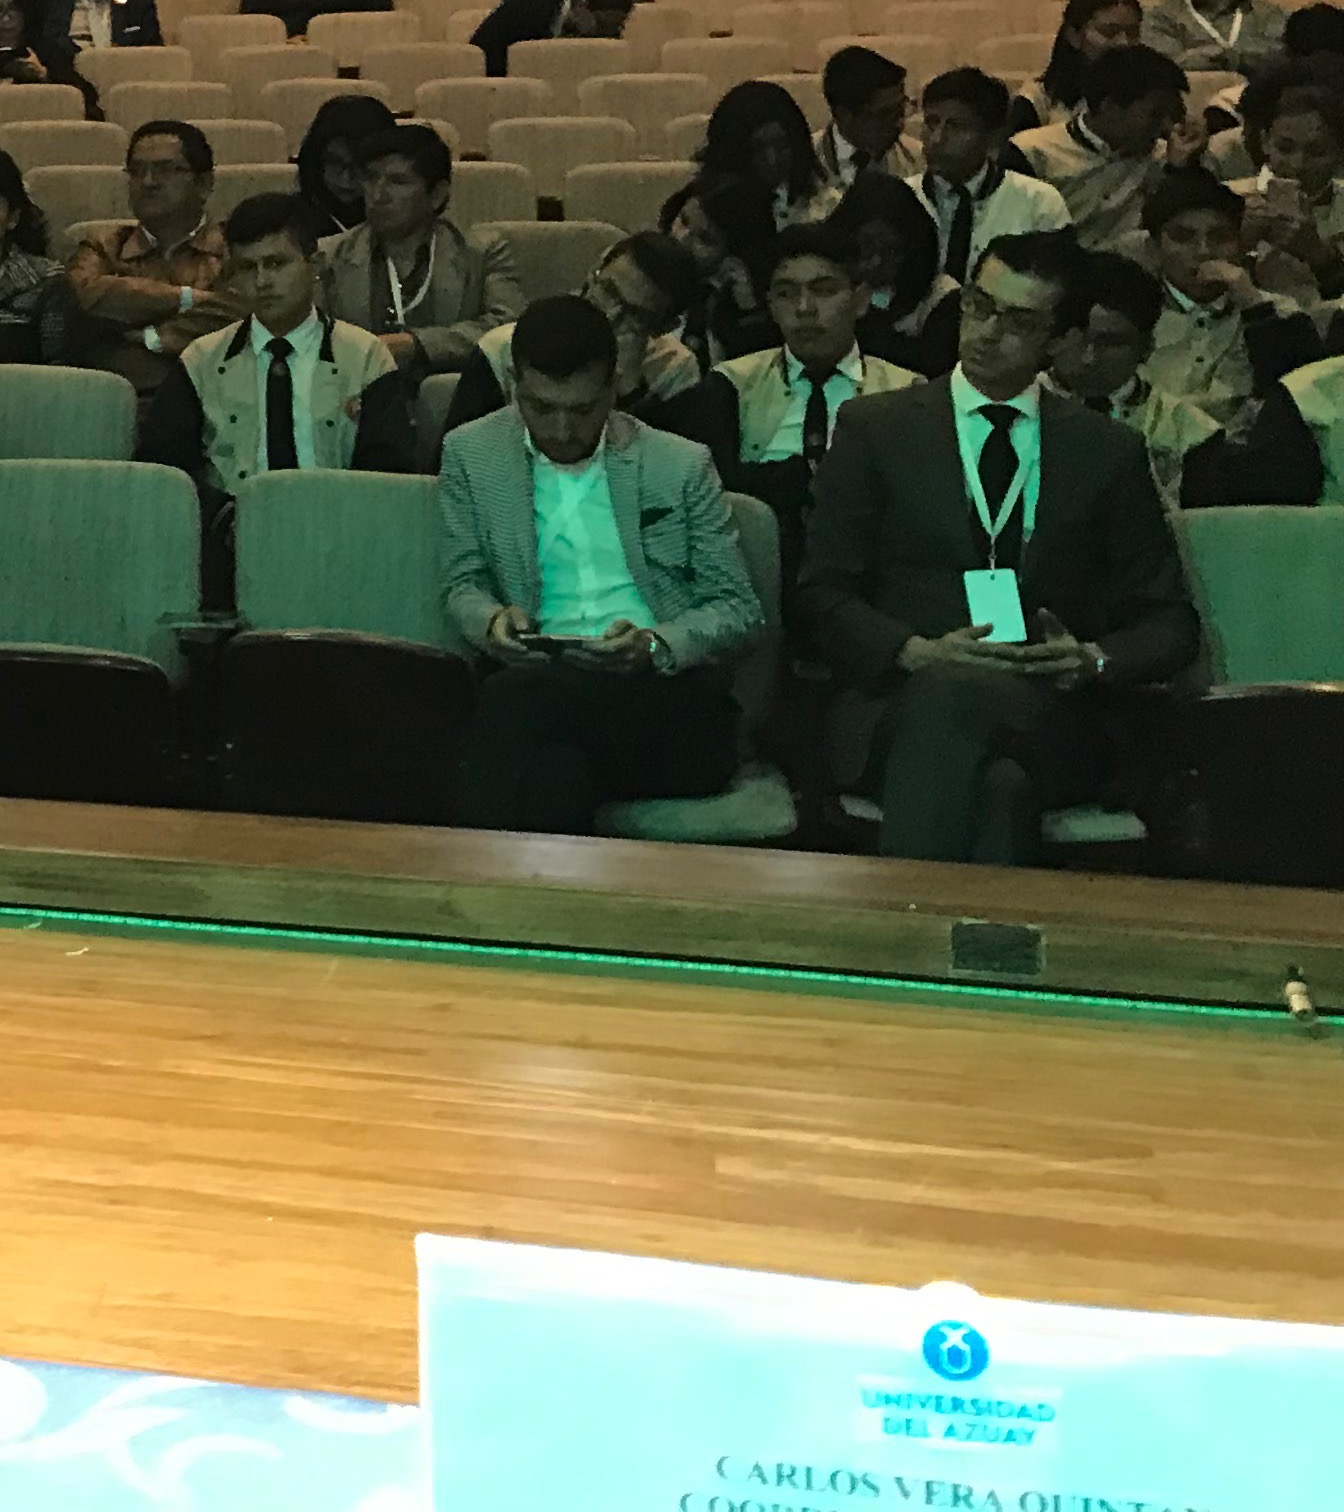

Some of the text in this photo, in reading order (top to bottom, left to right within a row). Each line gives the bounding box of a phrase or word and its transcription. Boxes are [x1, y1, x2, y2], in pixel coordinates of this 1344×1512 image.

[861, 1389, 1057, 1422] UNIVERSIDAD
[882, 1416, 1037, 1446] DEL AZUAY
[714, 1455, 881, 1499] CARLOS
[893, 1476, 1004, 1512] VERA
